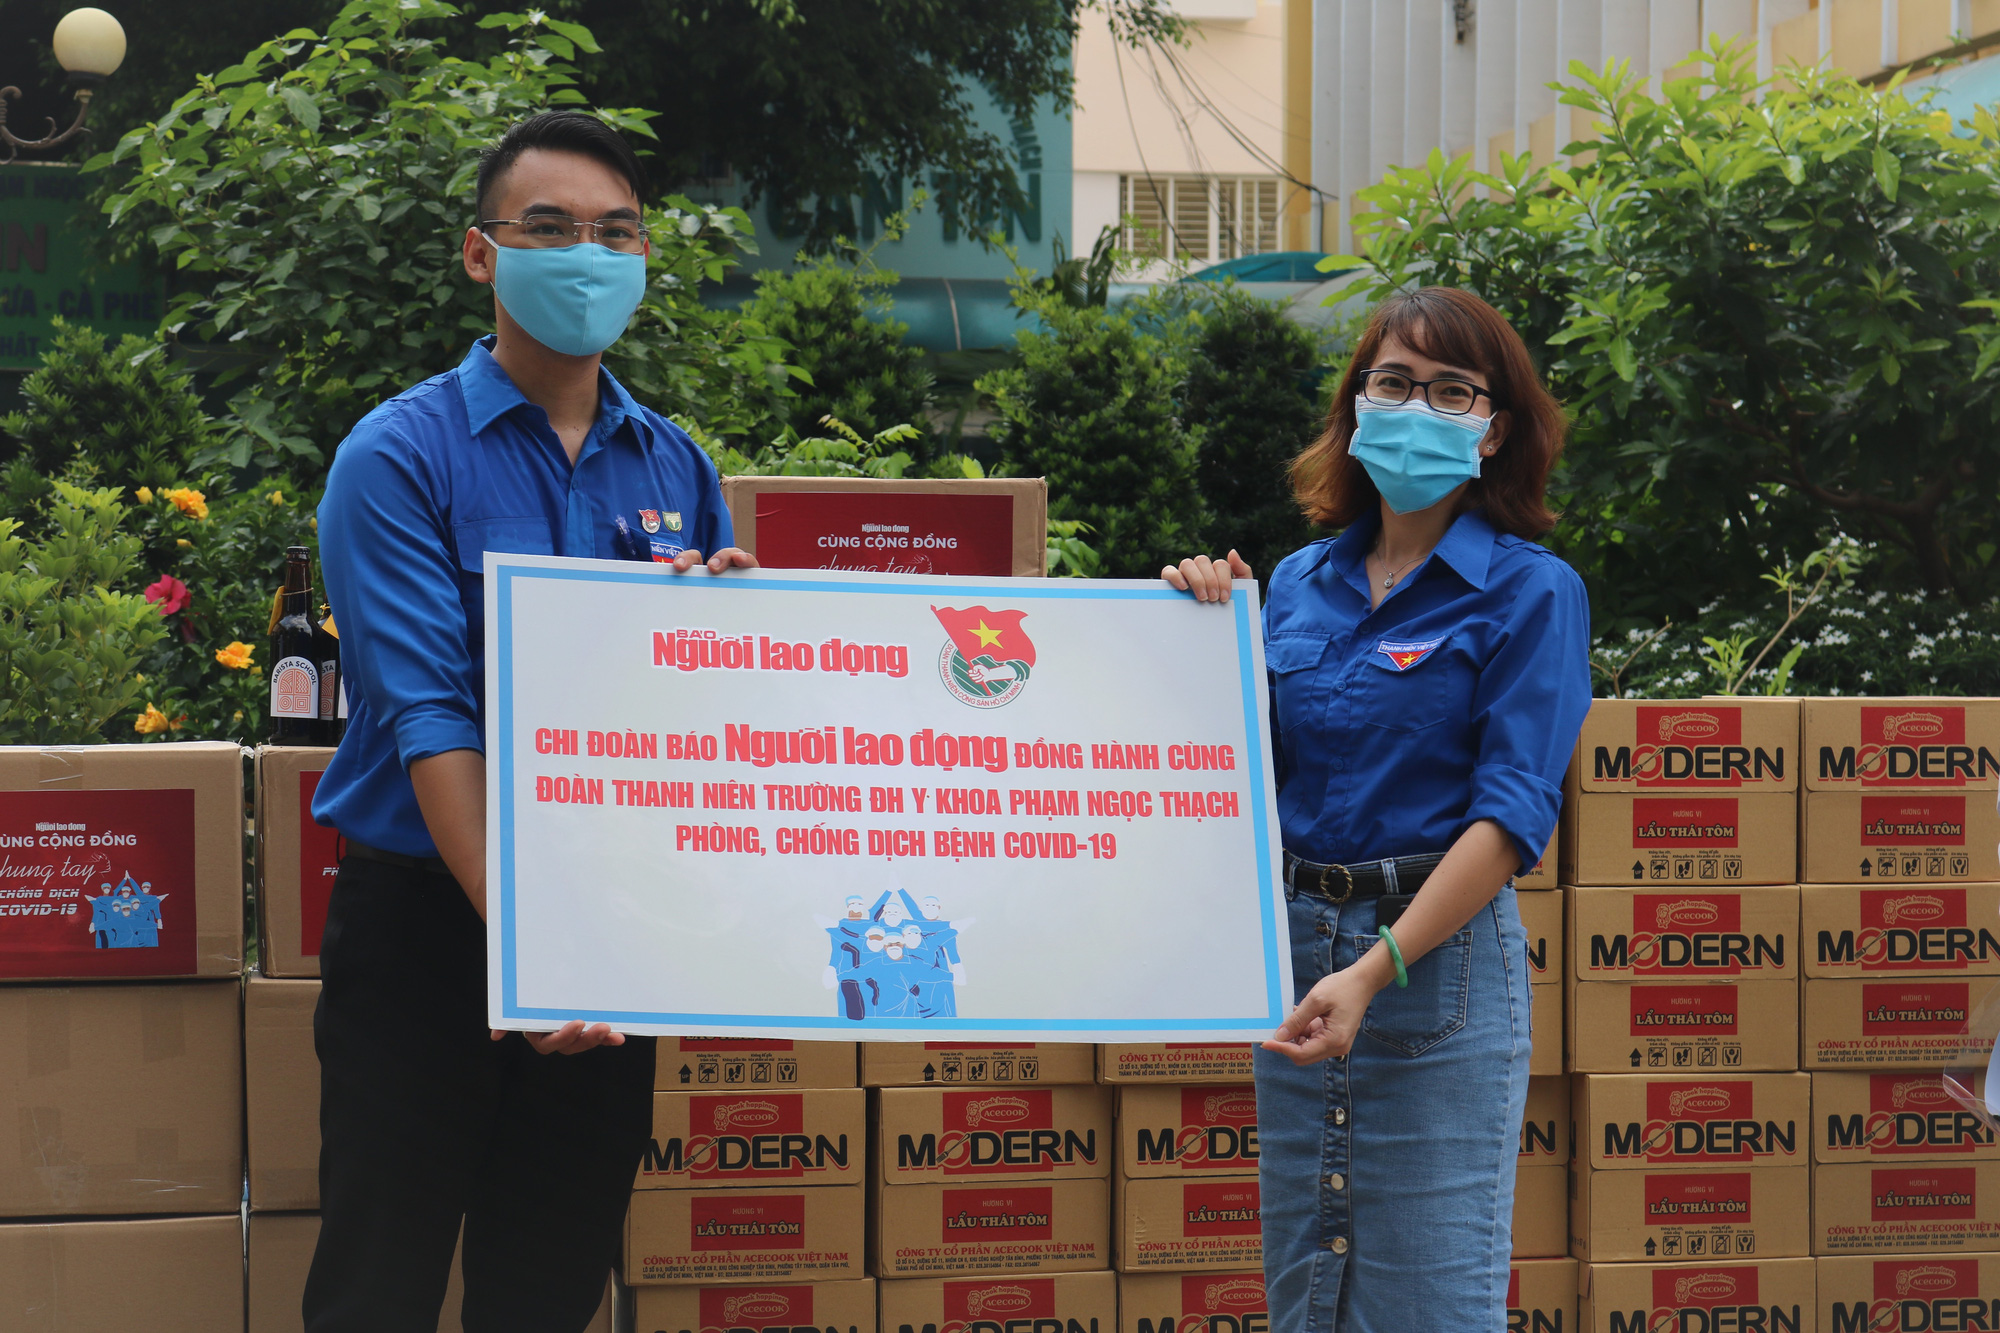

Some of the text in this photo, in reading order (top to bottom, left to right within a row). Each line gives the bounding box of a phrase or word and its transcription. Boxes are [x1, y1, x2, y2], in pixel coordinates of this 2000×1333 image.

[817, 533, 958, 551] CÙNG CỘNG ĐỒNG
[653, 632, 909, 678] Người lao động
[273, 661, 317, 685] BARISTA SCHOOL
[535, 723, 1235, 773] CHI ĐOÀN BÁO Người lao động ĐỒNG HÀNH CÙNG
[1594, 746, 1784, 779] MODERN
[536, 773, 1240, 823] ĐOÀN THANH NIÊN TRƯỜNG ĐH Y KHOA PHẠM NGỌC THẠCH
[1638, 821, 1735, 838] LẨU THÁI TÔM
[1866, 819, 1961, 835] LẨU THÁI TÔM
[39, 832, 85, 850] CỘNG
[89, 830, 137, 847] ĐỒNG
[676, 821, 1117, 863] PHÒNG, CHỐNG DỊCH BỆNH COVID-19
[60, 855, 96, 885] tay
[48, 888, 80, 901] DỊCH
[1591, 934, 1784, 966] MODERN
[1636, 1009, 1734, 1025] LẨU THÁI TÔM
[1867, 1006, 1964, 1021] LẨU THÁI TÔM
[1818, 1036, 1988, 1049] CÔNG TY CỔ PHẦN ACECOOK VIỆT
[1119, 1052, 1148, 1062] CÔNG
[1151, 1054, 1164, 1062] TY
[1166, 1050, 1181, 1061] CỔ
[1184, 1049, 1213, 1061] PHẦN
[1138, 1126, 1260, 1161] MODE
[1605, 1120, 1795, 1154] MODERN
[643, 1134, 847, 1171] MODERN
[898, 1129, 1095, 1166] MODERN
[1650, 1198, 1747, 1214] LẨU THÁI TÔM
[1876, 1190, 1971, 1207] LẨU THÁI TÔM
[947, 1211, 1048, 1228] LẨU THÁI TÔM
[1188, 1206, 1253, 1223] LẨU THÁI
[696, 1219, 800, 1236] LẨU THÁI TÔM
[896, 1242, 1095, 1257] CÔNG TY CỔ PHẦN ACECOOK VIỆT NAM
[1138, 1241, 1167, 1251] CÔNG
[1169, 1242, 1182, 1250] TY
[1185, 1238, 1199, 1249] CỔ
[1202, 1237, 1230, 1249] PHẦN
[643, 1251, 848, 1265] CÔNG TY CỔ PHẦN ACECOOK VIỆT NAM
[1610, 1305, 1800, 1333] MODERN
